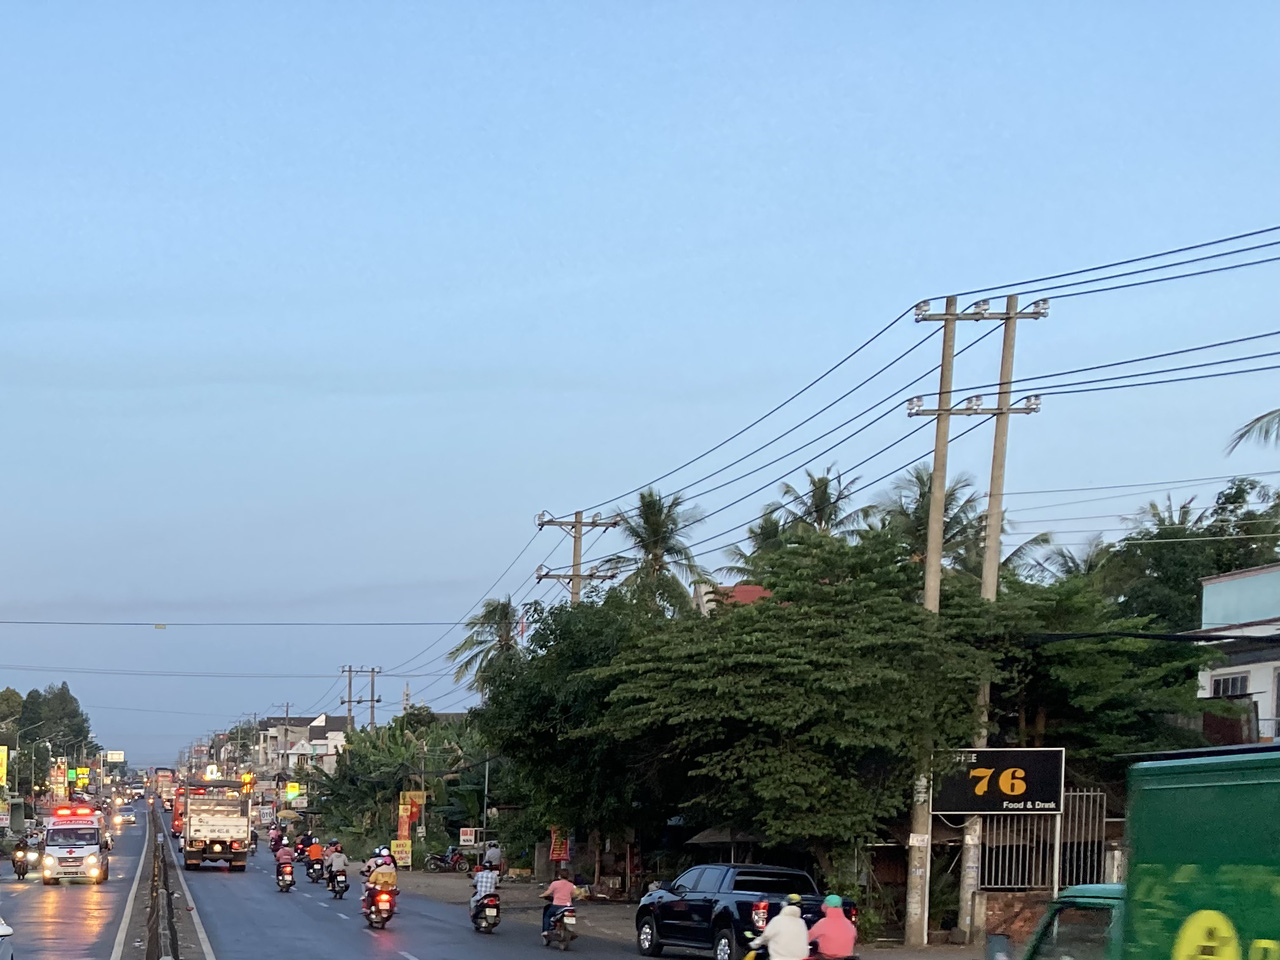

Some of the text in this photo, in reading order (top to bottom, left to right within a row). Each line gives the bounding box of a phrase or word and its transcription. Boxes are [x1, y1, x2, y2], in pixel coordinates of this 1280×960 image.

[969, 767, 1027, 796] 76
[1003, 801, 1056, 809] Food & Drink
